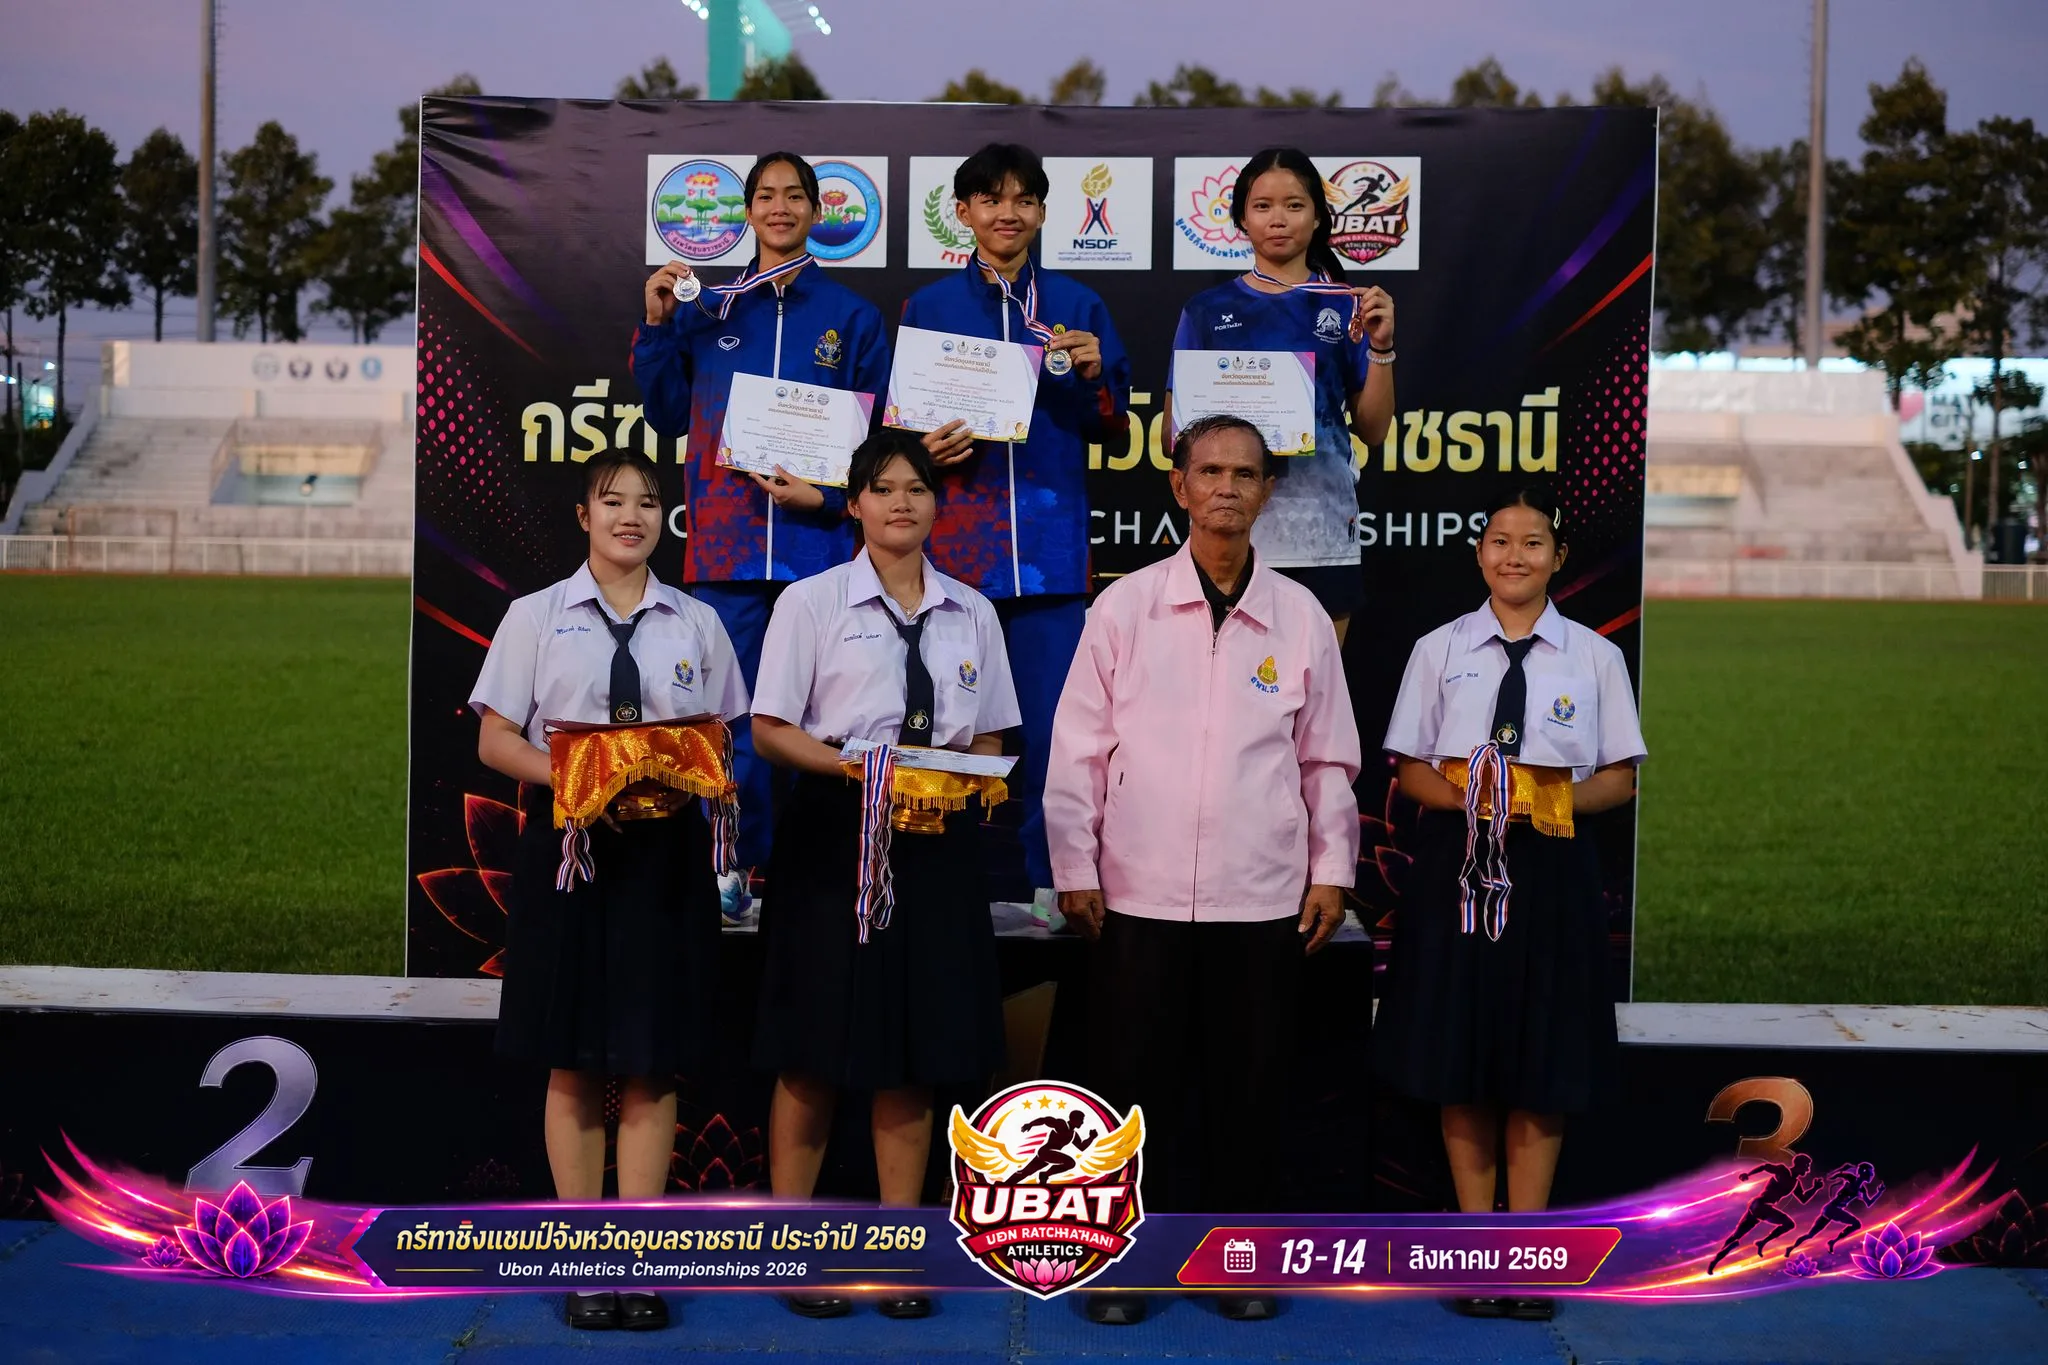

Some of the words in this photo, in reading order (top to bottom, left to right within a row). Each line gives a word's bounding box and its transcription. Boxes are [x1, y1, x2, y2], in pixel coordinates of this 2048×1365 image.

[1331, 214, 1403, 235] UBAT
[1073, 239, 1118, 249] NSDF
[183, 1035, 318, 1198] 2
